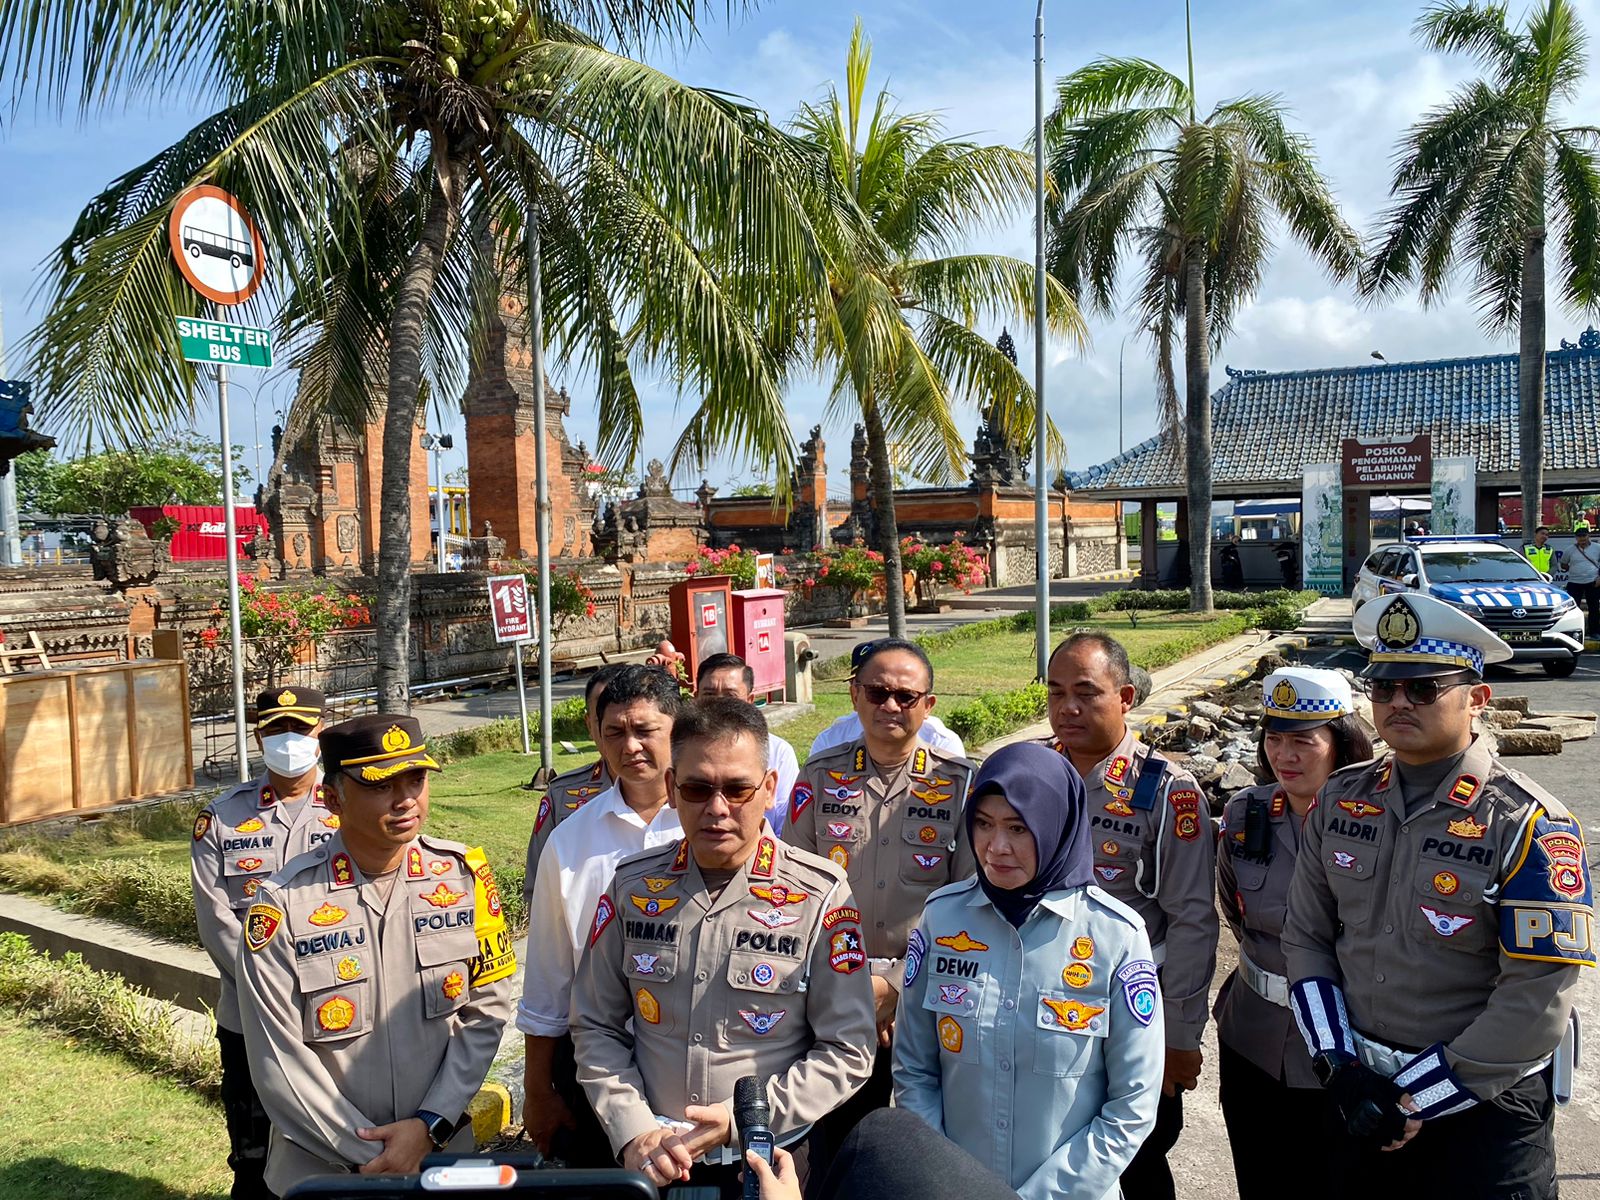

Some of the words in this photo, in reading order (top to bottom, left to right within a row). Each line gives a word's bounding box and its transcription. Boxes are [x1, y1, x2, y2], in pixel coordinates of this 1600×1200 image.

[178, 321, 269, 347] SHELTER
[209, 343, 241, 362] BUS
[1365, 446, 1407, 457] POSKO
[1351, 455, 1422, 466] PENGAMANAN
[1356, 463, 1416, 474] PELABUHAN
[1359, 471, 1415, 482] GILIMANUK
[495, 585, 512, 613] 1
[505, 617, 519, 625] FIRE
[703, 609, 715, 622] 1B
[498, 623, 527, 633] HYDRANT
[759, 636, 769, 648] 1A
[1172, 791, 1196, 802] POLDA
[822, 803, 862, 816] EDDY
[907, 806, 951, 821] POLRI
[1091, 816, 1140, 836] POLRI
[1328, 817, 1378, 842] ALDRI
[223, 837, 261, 851] DEWA
[262, 836, 274, 848] W
[1547, 839, 1579, 851] POLDA
[1422, 837, 1494, 867] POLRI
[414, 908, 474, 933] POLRI
[824, 909, 859, 926] KORLANTAS
[625, 920, 678, 943] FIRMAN
[1514, 908, 1589, 952] PJ
[296, 932, 352, 957] DEWA
[355, 928, 365, 945] J
[736, 930, 798, 956] POLRI
[936, 956, 979, 979] DEWI
